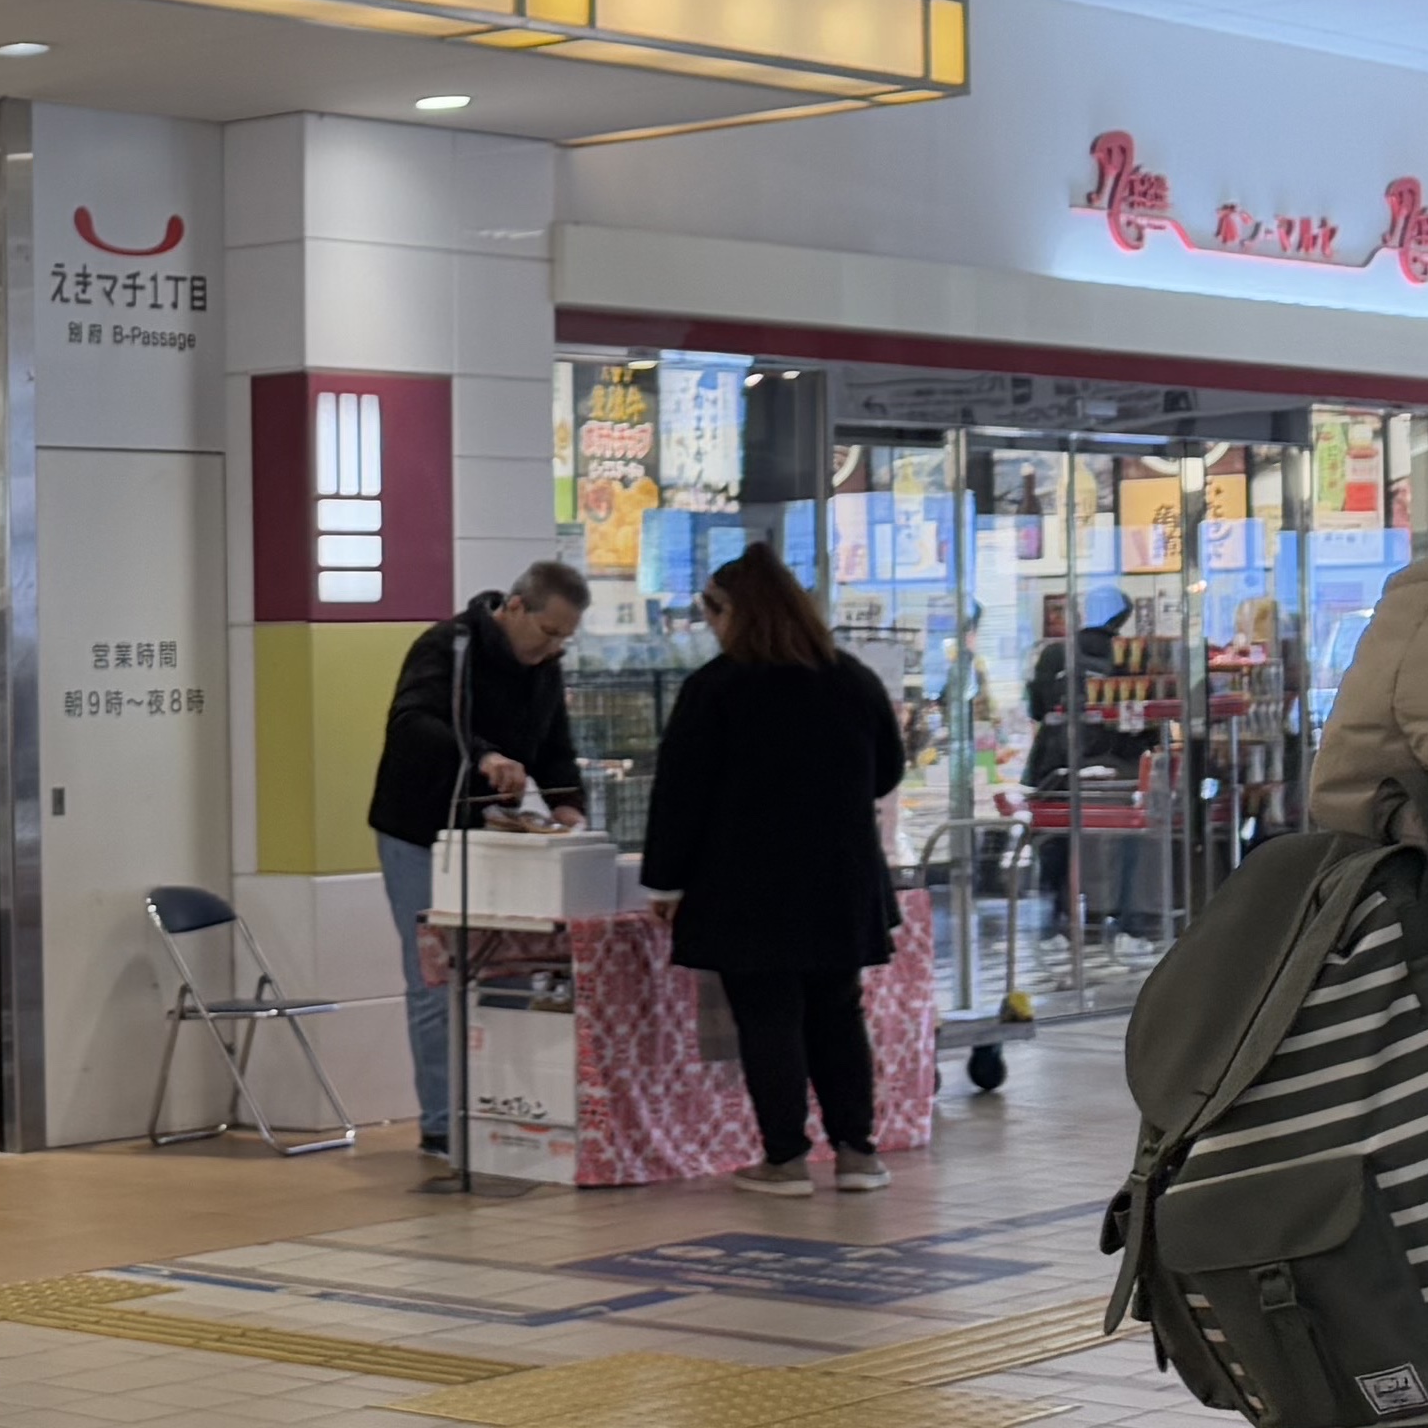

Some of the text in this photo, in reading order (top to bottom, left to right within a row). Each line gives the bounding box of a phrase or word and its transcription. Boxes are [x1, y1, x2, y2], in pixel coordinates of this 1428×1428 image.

[51, 263, 207, 312] えきマチ1丁目
[112, 324, 196, 351] B-Passage
[92, 641, 177, 669] 営業時間
